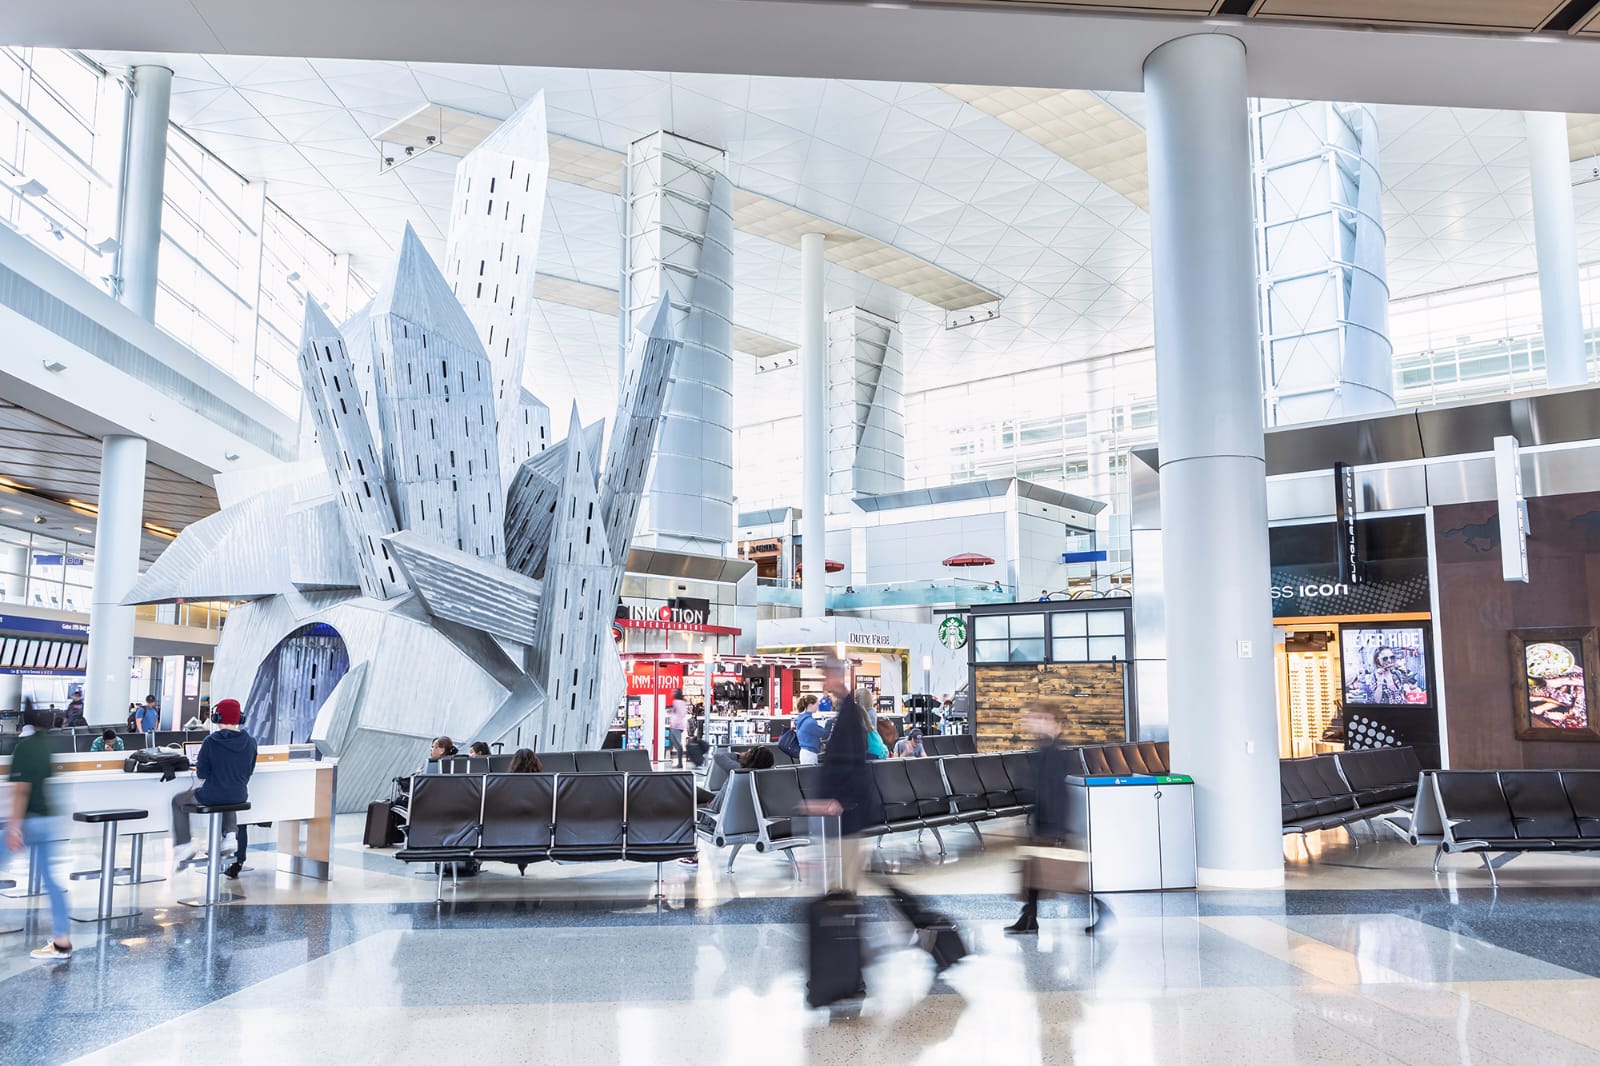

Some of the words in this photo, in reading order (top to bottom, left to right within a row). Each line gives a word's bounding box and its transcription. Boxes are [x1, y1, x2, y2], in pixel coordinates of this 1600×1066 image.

[628, 620, 704, 631] ENTERTAINMENT
[849, 632, 871, 645] DUTY
[871, 634, 890, 645] FREE
[1389, 632, 1420, 647] HIDE
